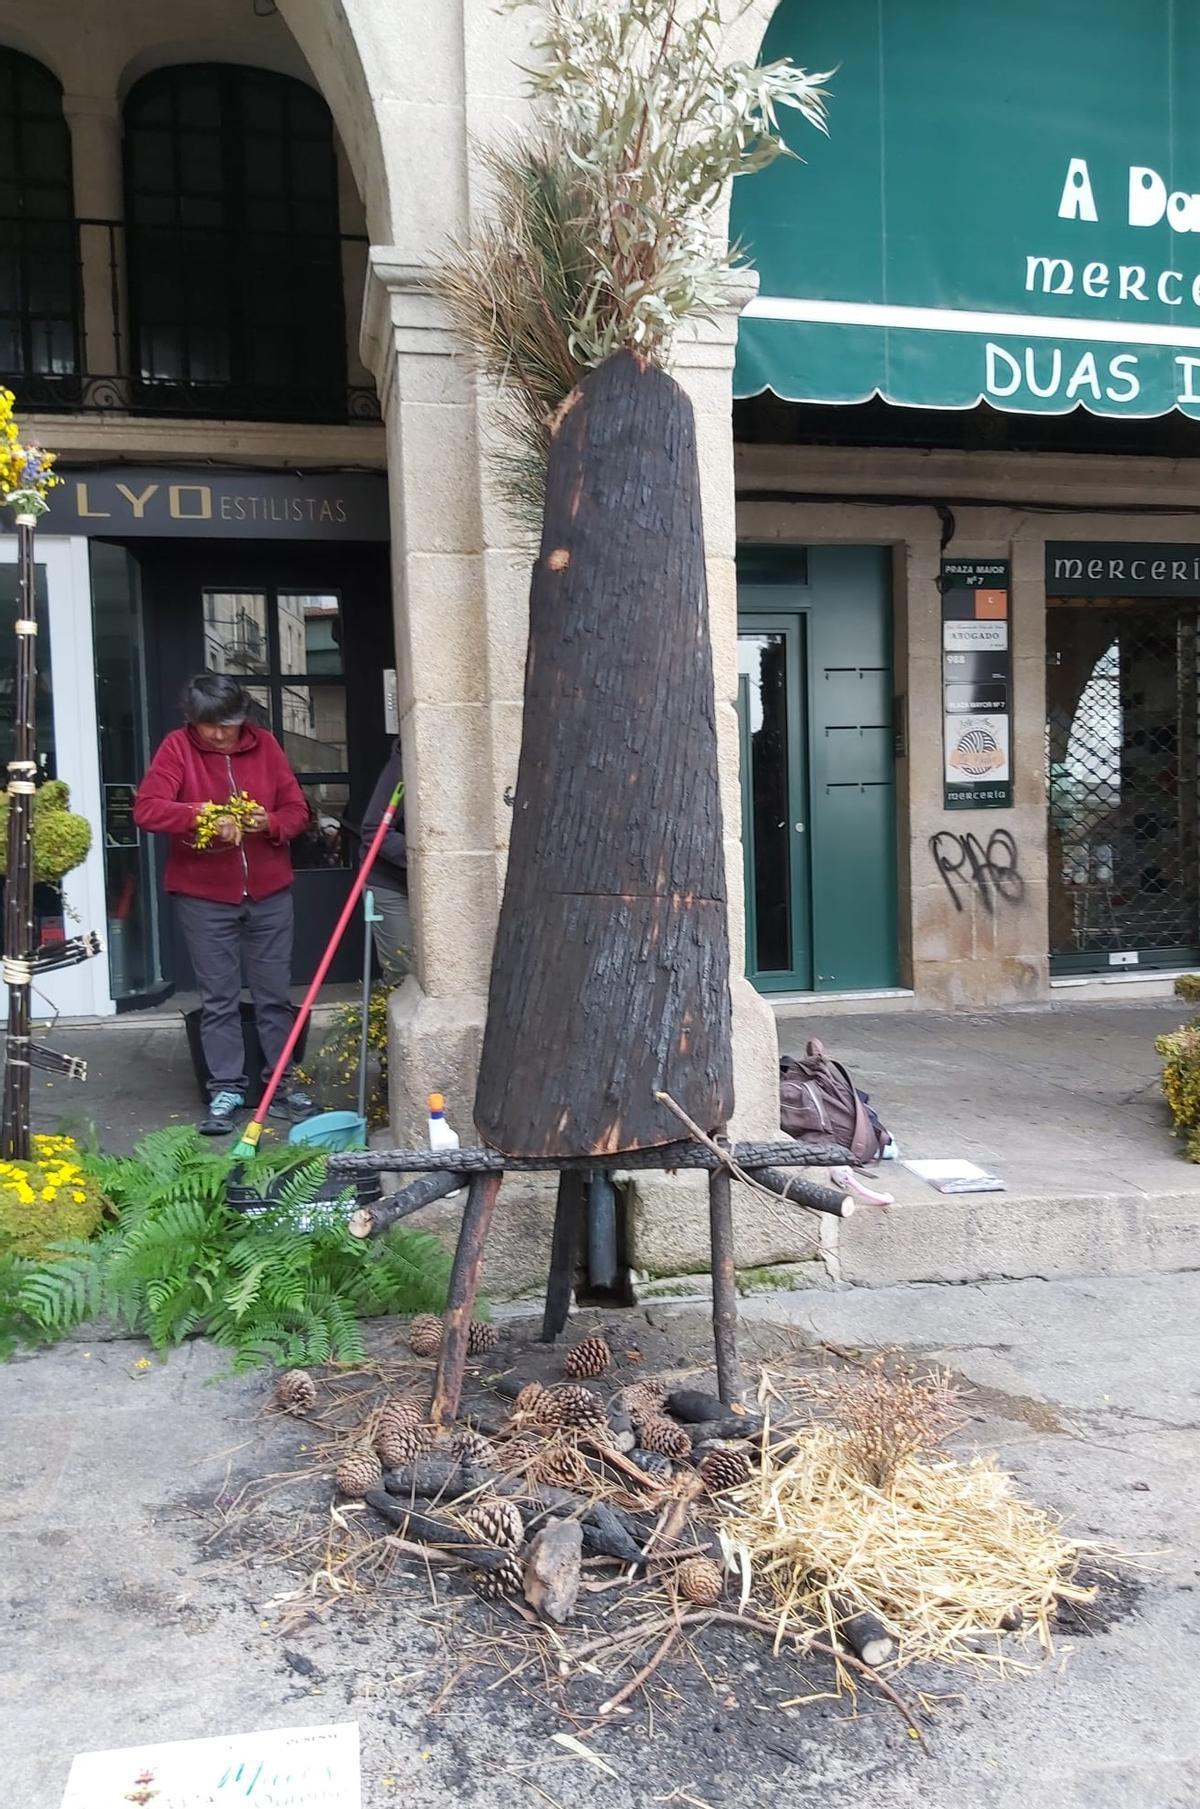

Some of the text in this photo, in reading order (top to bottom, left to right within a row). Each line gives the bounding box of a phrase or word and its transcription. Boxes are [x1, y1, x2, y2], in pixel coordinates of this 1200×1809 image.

[1057, 157, 1099, 222] A
[985, 342, 1141, 402] DUAS
[75, 482, 348, 523] LYO ESTILISTAS
[944, 565, 1005, 574] PRAZA MAIOR
[951, 632, 1000, 641] ABOGADO
